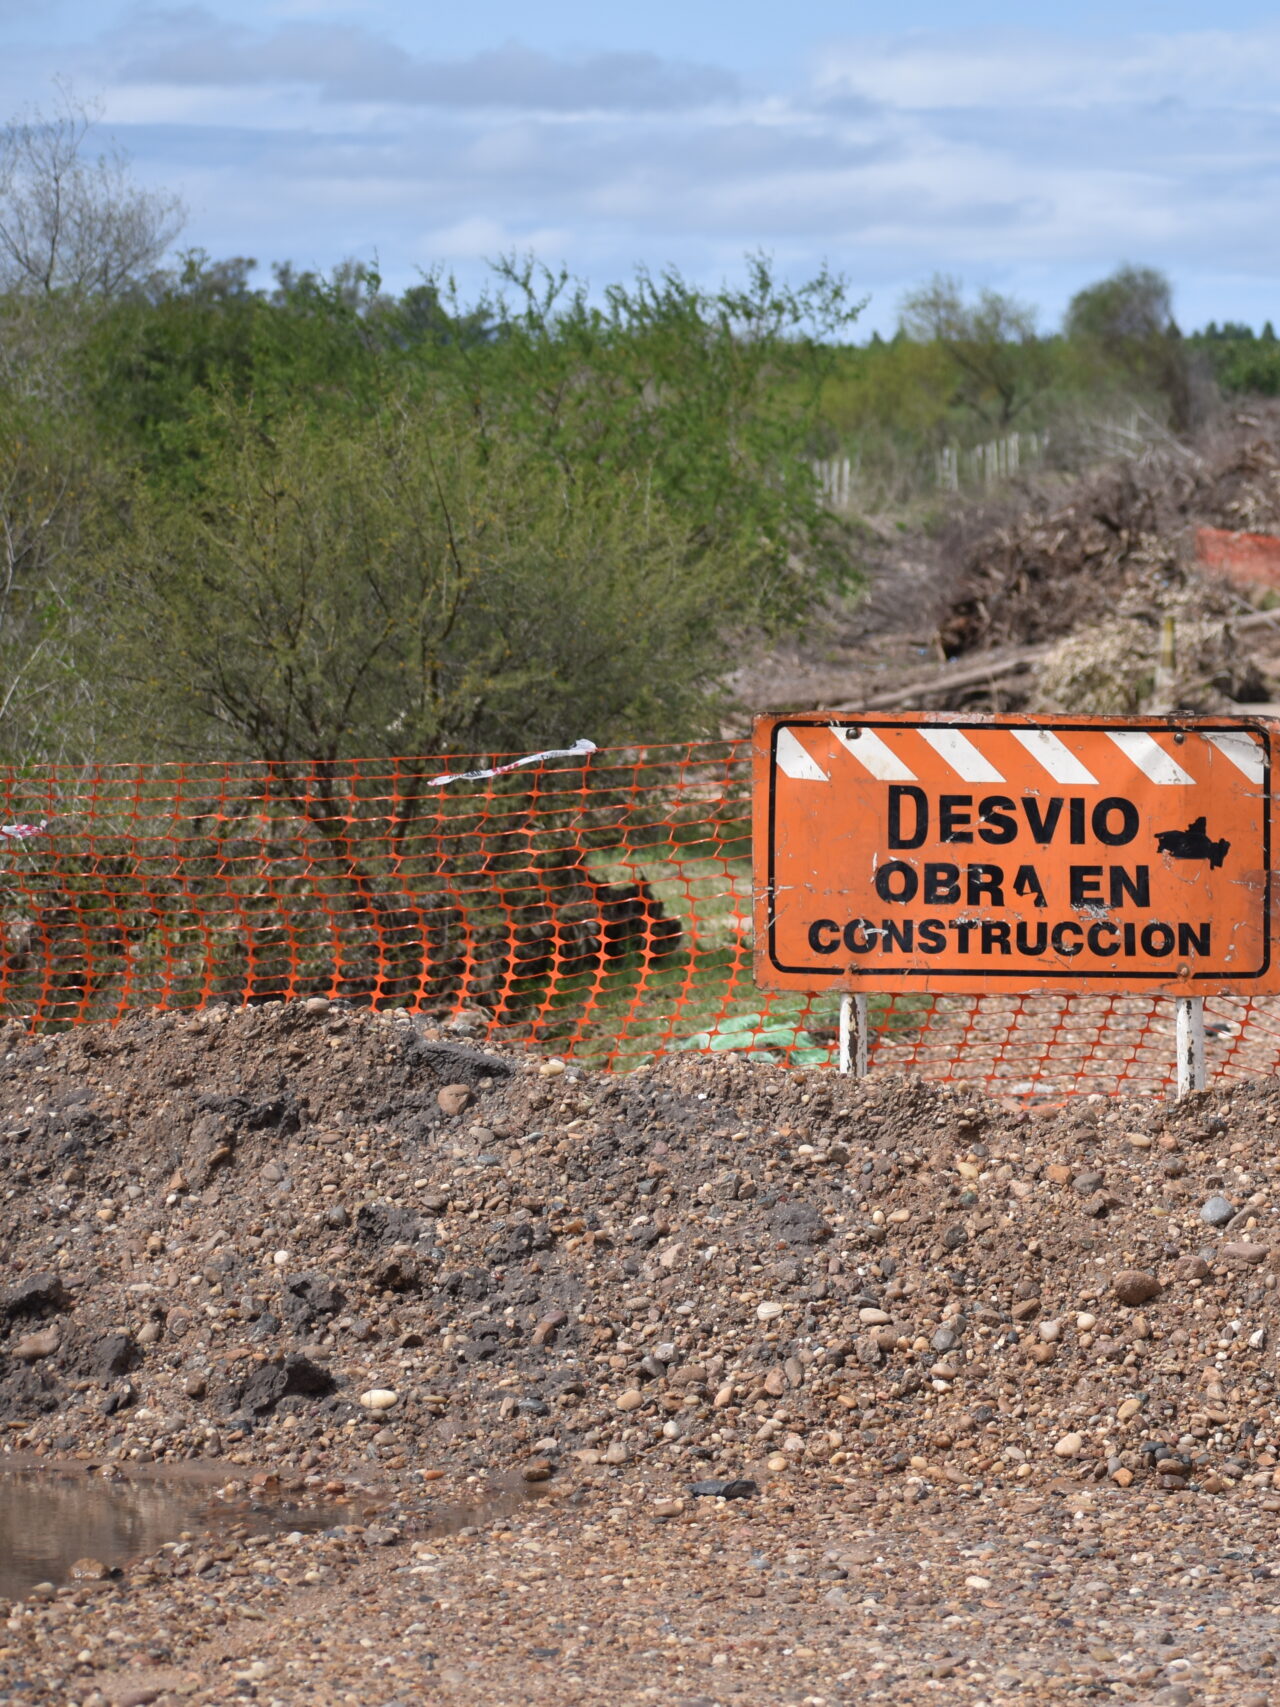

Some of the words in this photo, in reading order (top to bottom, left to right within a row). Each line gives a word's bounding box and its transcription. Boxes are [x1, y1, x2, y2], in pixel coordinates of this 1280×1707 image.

[887, 784, 1140, 850] DESVIO
[874, 860, 1048, 908] OBRA
[1069, 865, 1151, 910] EN
[808, 918, 1211, 957] CONSTRUCCION
